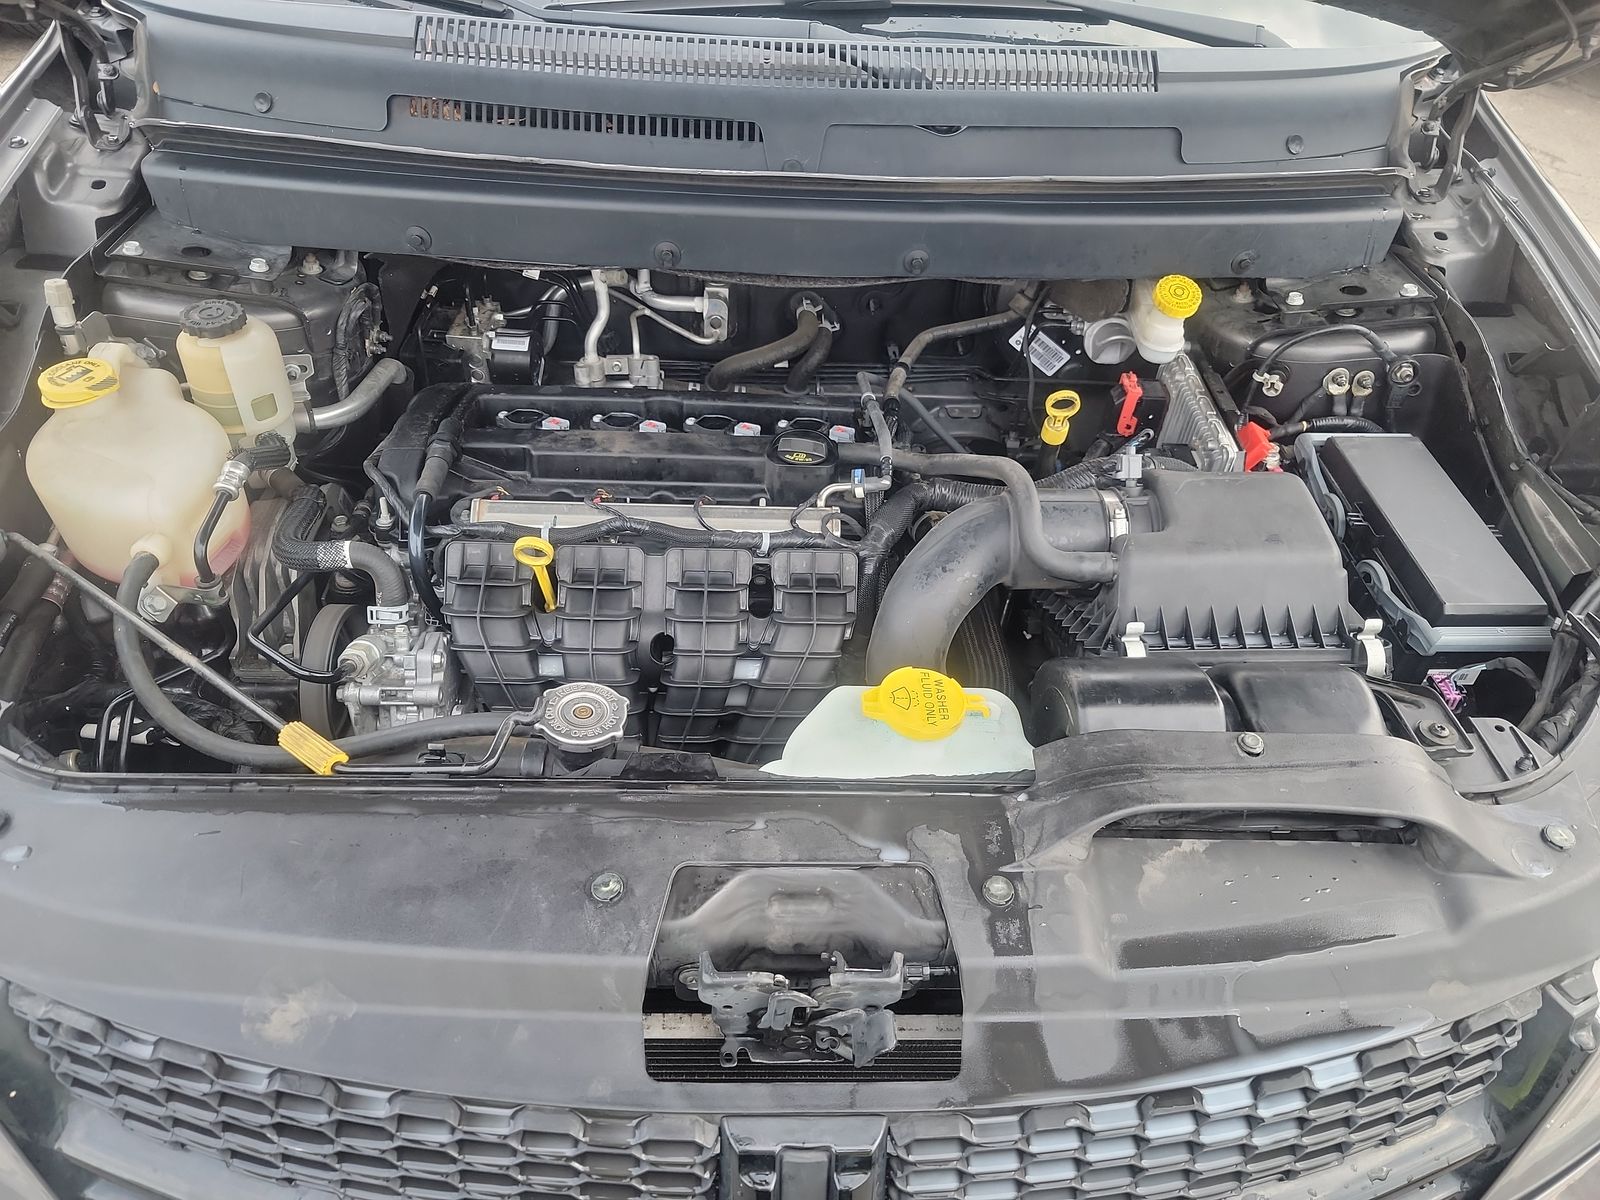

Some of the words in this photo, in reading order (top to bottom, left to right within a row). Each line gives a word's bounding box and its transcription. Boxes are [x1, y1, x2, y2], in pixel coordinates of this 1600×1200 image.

[556, 684, 586, 698] KEEP
[593, 685, 618, 702] TIGHT
[920, 671, 934, 699] FLUID
[924, 699, 938, 727] ONLY
[934, 679, 950, 721] WASHER
[548, 719, 570, 734] NOT
[571, 728, 603, 738] OPEN
[602, 714, 619, 731] HOT
